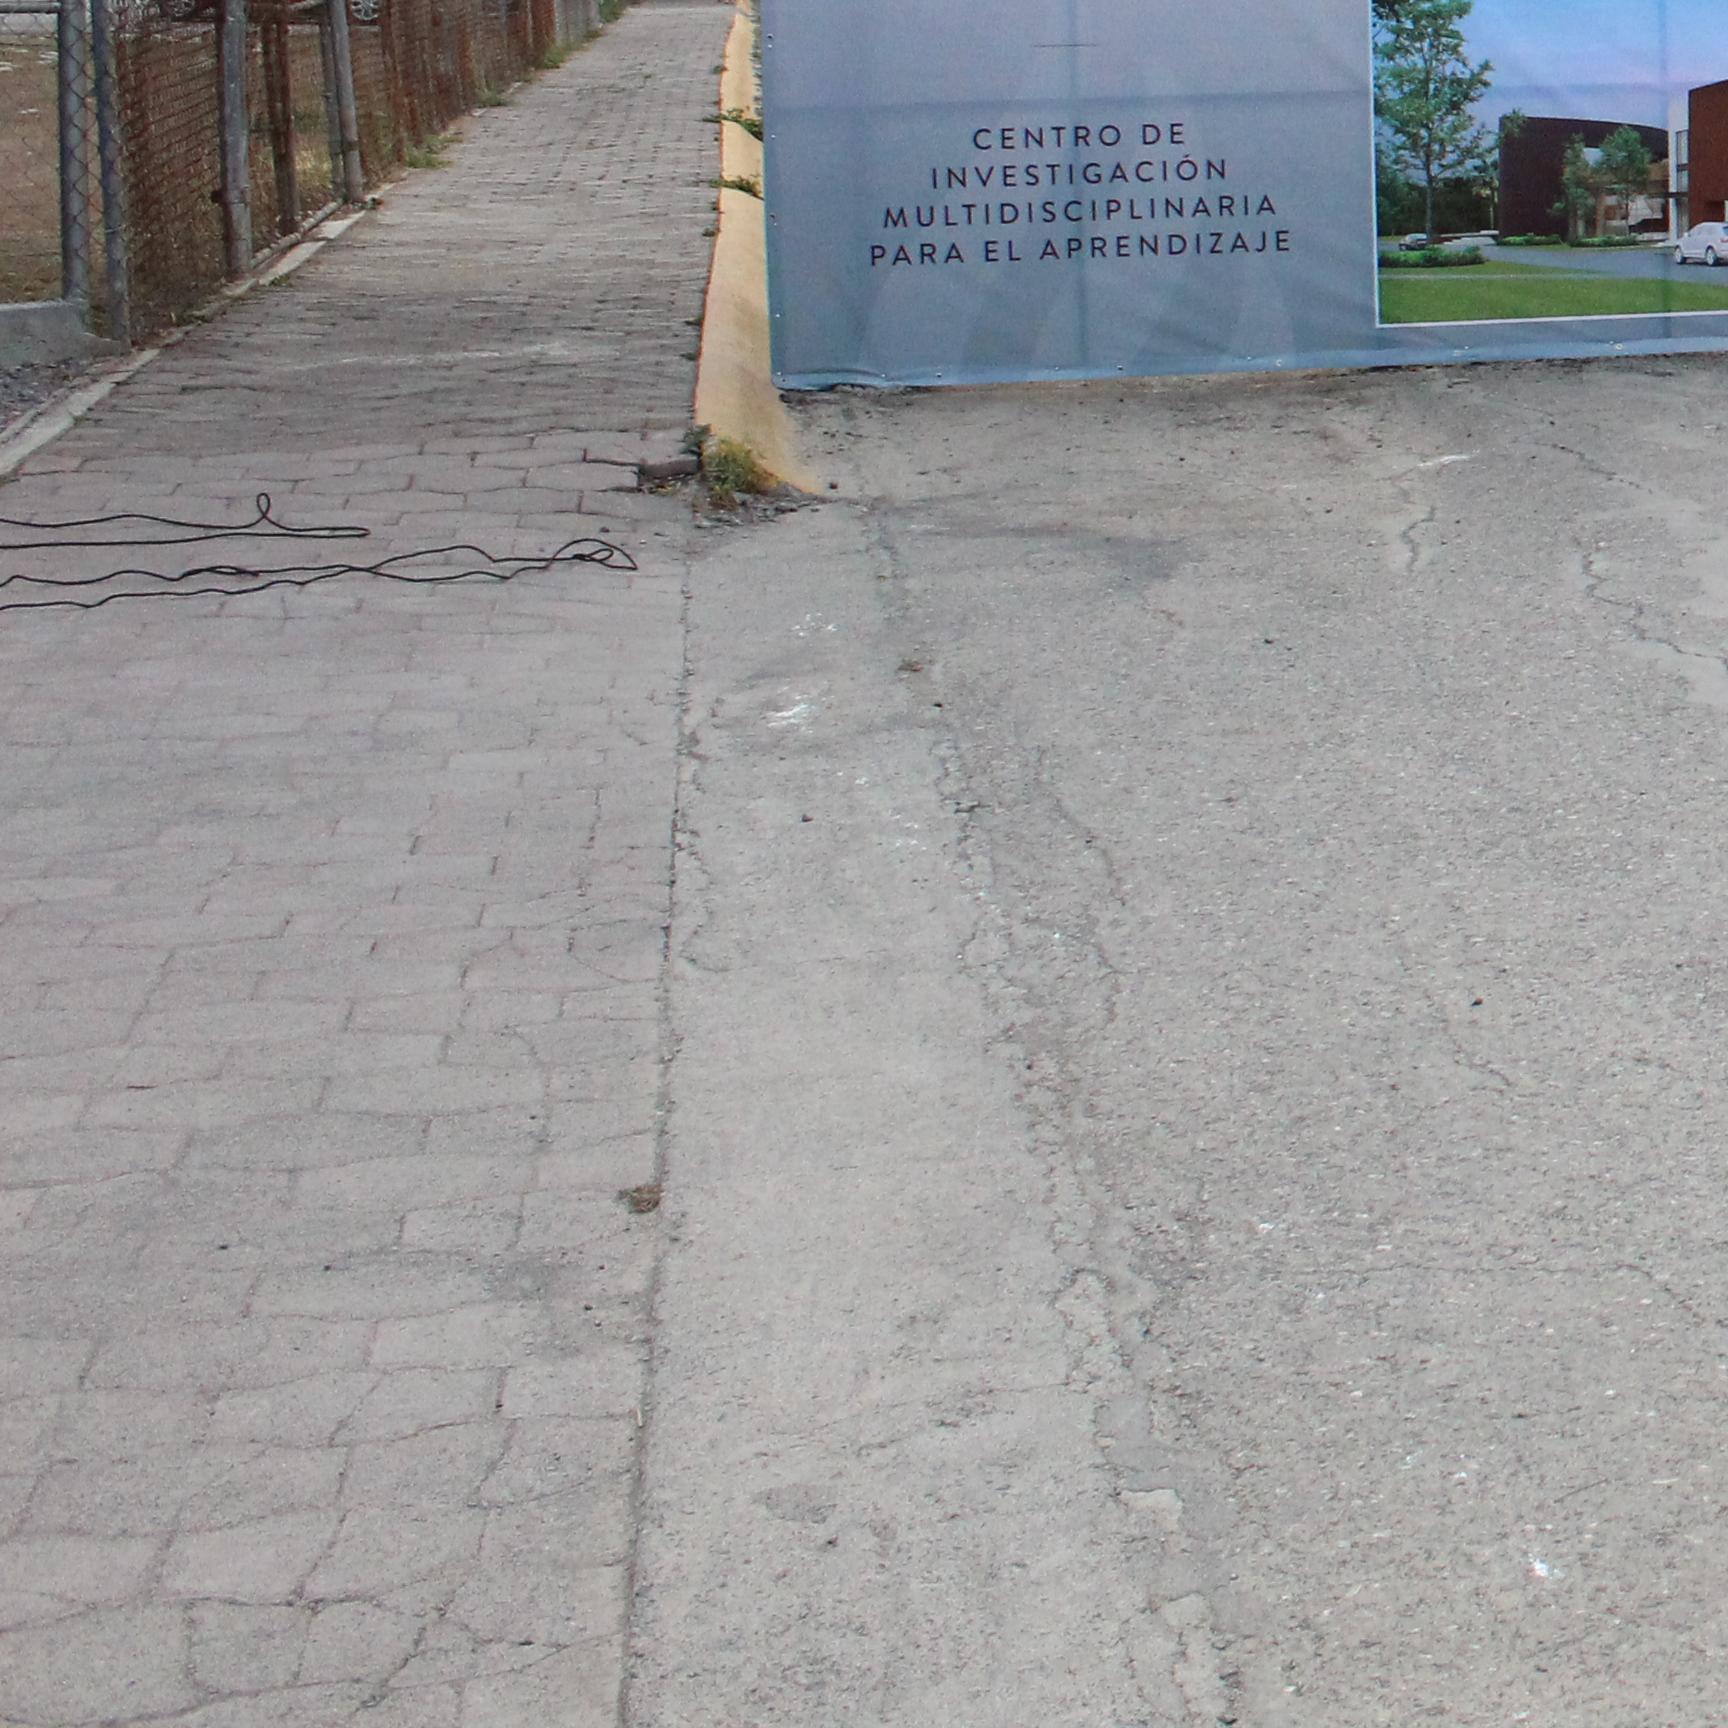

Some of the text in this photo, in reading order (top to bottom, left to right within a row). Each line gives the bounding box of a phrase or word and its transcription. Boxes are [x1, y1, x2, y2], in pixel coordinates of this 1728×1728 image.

[973, 122, 1185, 151] CENTRO DE
[932, 154, 1227, 190] INVESTIGACIÓN
[883, 194, 1277, 229] MULTIDISCIPLINARIA
[870, 229, 1292, 267] PARA EL APRENDIZAJE
